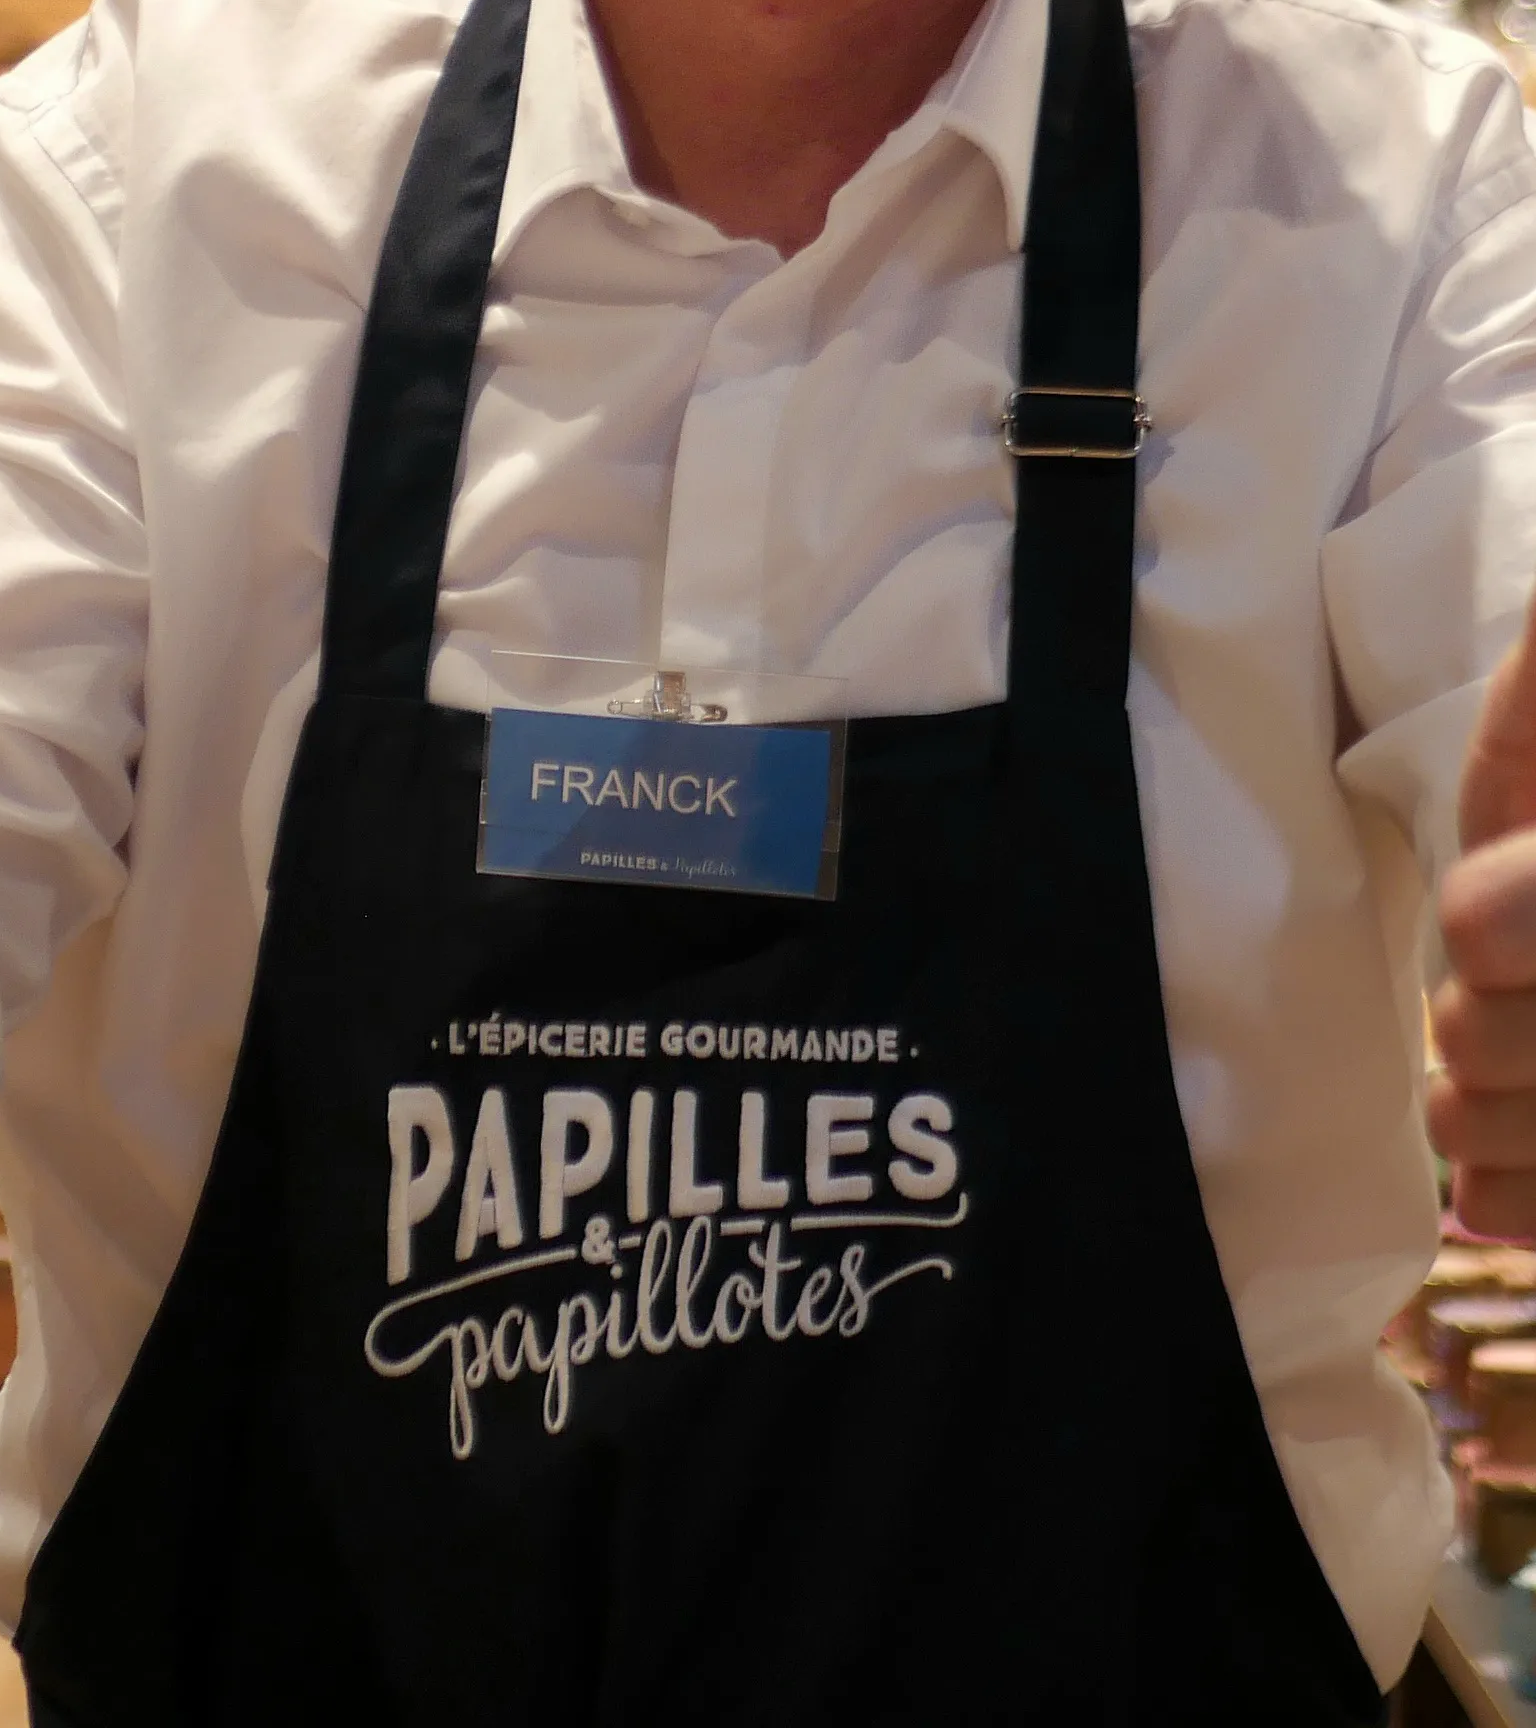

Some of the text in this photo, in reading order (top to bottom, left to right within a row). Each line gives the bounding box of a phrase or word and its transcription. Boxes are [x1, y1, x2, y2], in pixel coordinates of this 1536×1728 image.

[530, 761, 738, 818] FRANCK
[580, 851, 657, 871] PAPILLES
[447, 1013, 901, 1063] L'ÉPICERIE GOURMANDE
[386, 1084, 959, 1287] PAPILLES
[579, 1215, 617, 1265] &
[364, 1215, 954, 1460] papillotes
